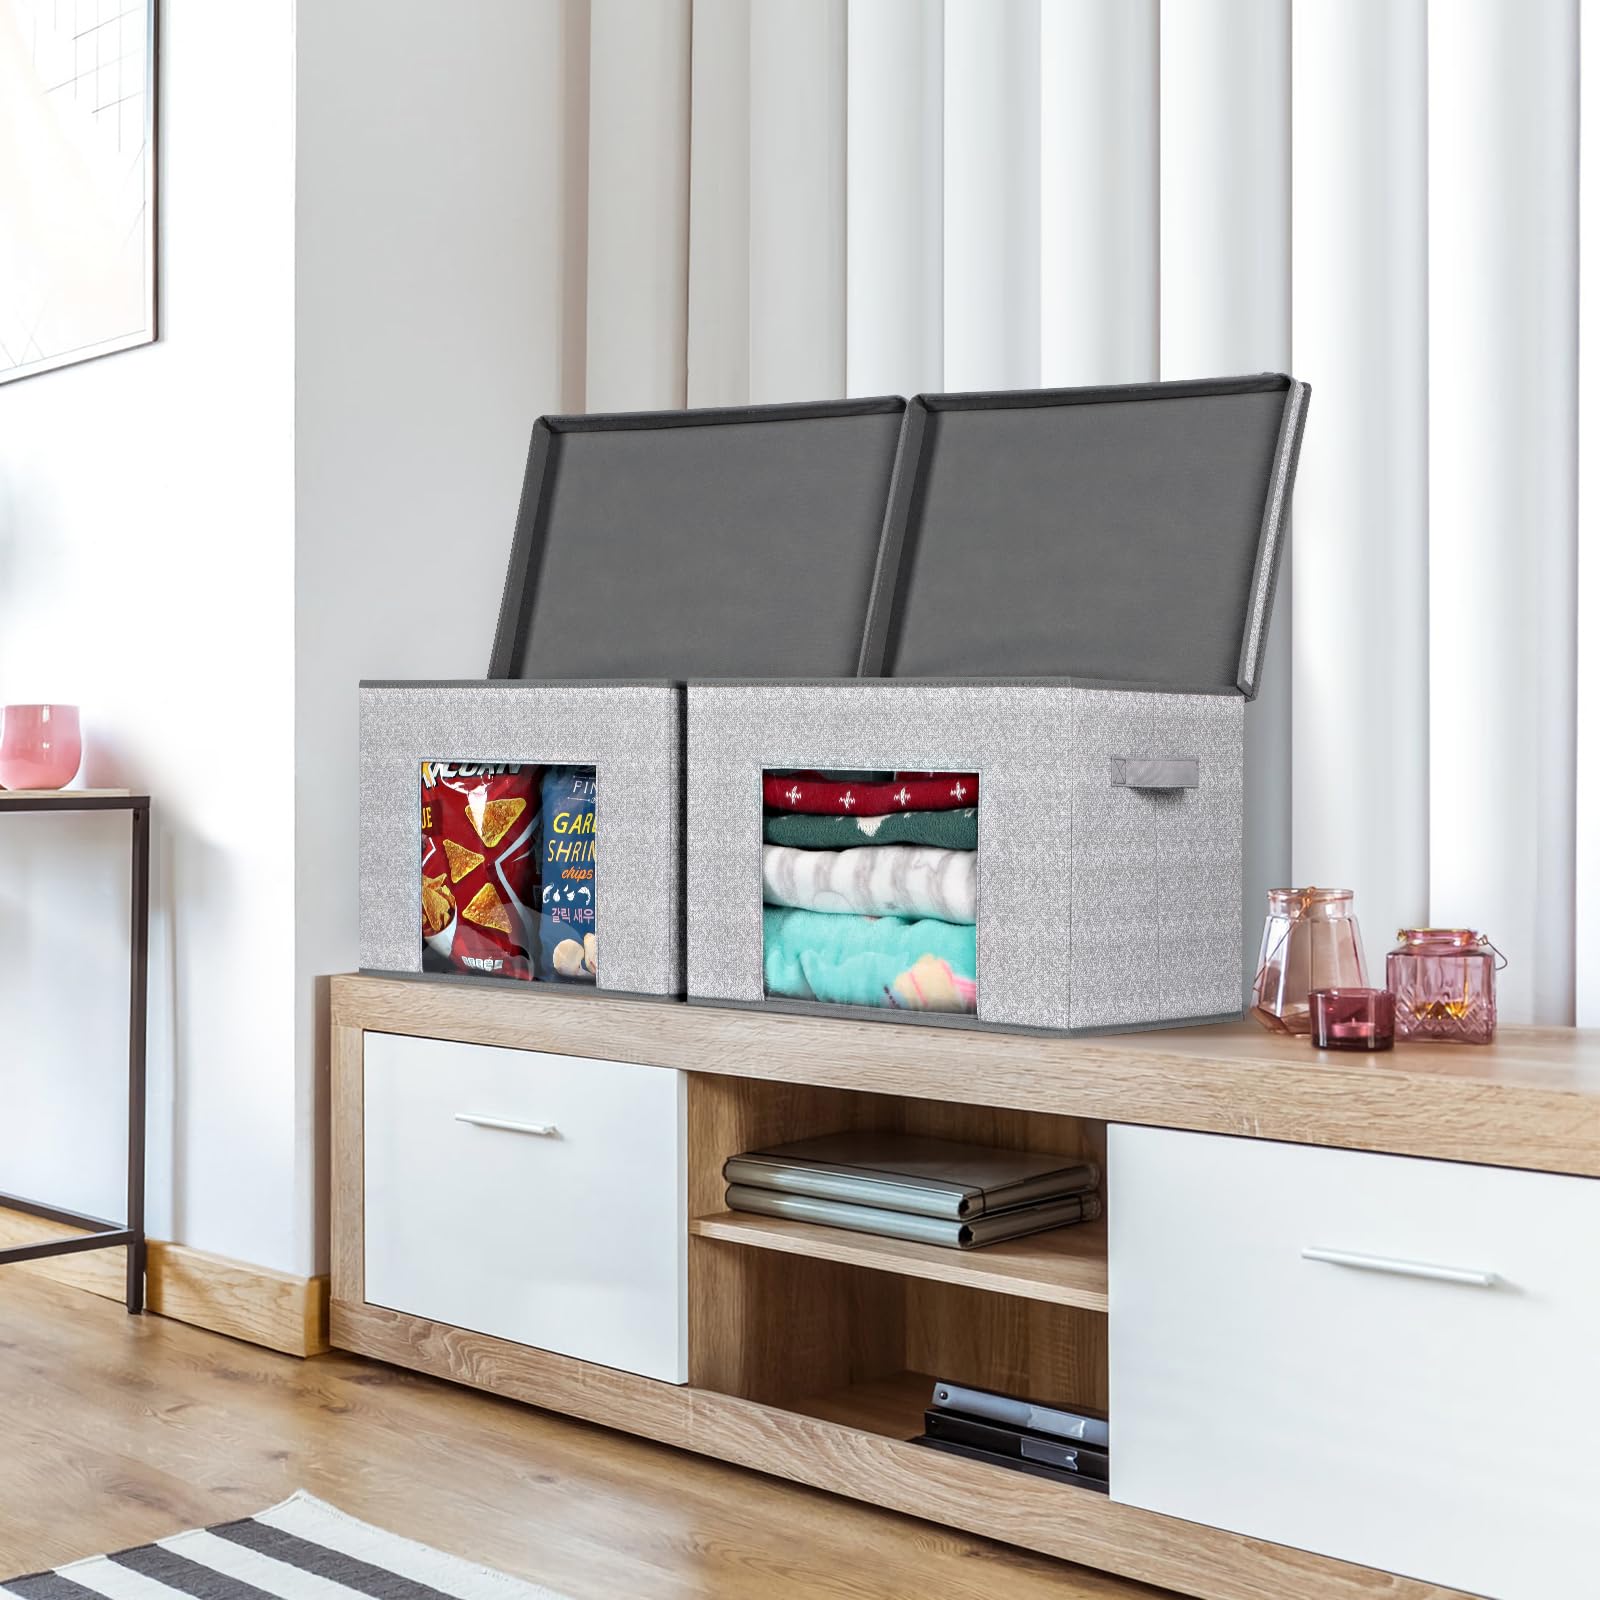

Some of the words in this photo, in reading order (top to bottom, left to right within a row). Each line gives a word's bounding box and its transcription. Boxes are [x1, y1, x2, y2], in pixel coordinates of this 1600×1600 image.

[561, 866, 593, 882] chips
[551, 907, 571, 923] 갈릭
[573, 907, 595, 924] 새우
